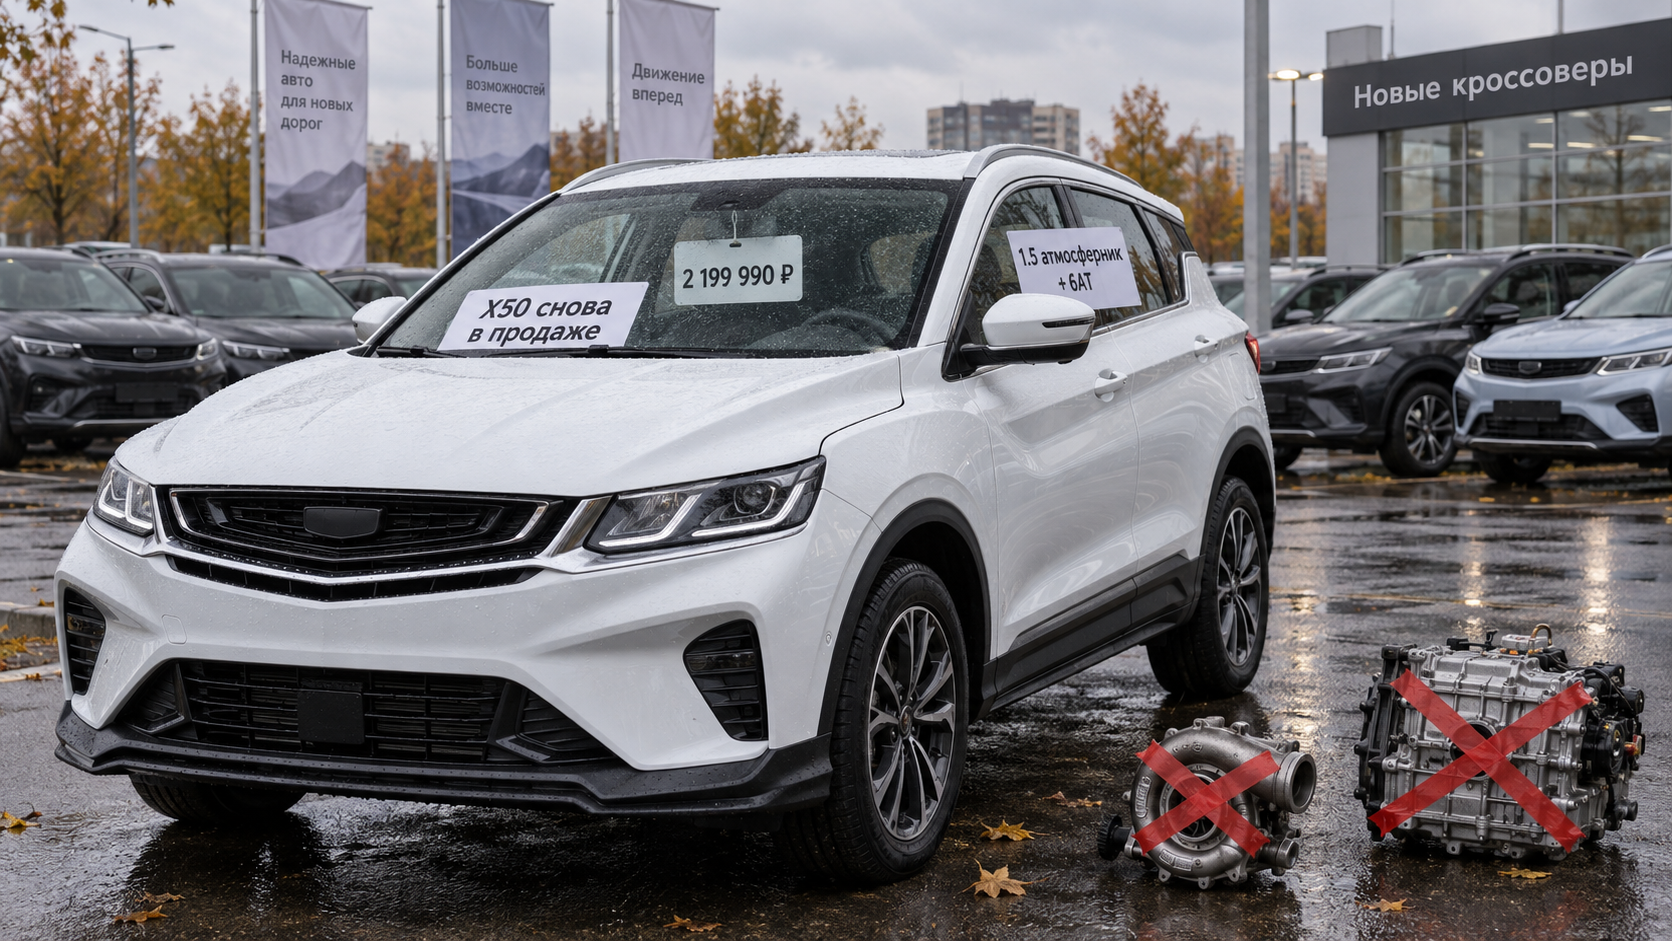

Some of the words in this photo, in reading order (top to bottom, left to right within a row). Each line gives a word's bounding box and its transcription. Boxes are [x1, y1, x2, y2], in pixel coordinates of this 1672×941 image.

[281, 49, 356, 71] Надежные
[465, 54, 518, 74] Больше
[281, 73, 314, 88] авто
[631, 62, 706, 85] Движение
[1354, 80, 1441, 108] Новые
[1452, 55, 1633, 101] кроссоверы
[466, 79, 546, 97] возможностей
[632, 87, 684, 107] вперед
[281, 95, 307, 110] для
[310, 98, 354, 112] новых
[466, 100, 513, 115] вместе
[281, 117, 324, 133] дорог
[1018, 247, 1039, 267] 1.5
[1040, 244, 1124, 267] атмосферник
[682, 268, 694, 289] 2
[700, 266, 732, 289] 199
[738, 264, 775, 287] 990
[780, 264, 794, 285] ₽
[1058, 277, 1067, 291] +
[1068, 272, 1093, 292] 6AT
[478, 298, 532, 320] X50
[536, 299, 613, 319] снова
[466, 327, 484, 343] в
[489, 322, 602, 347] продаже
